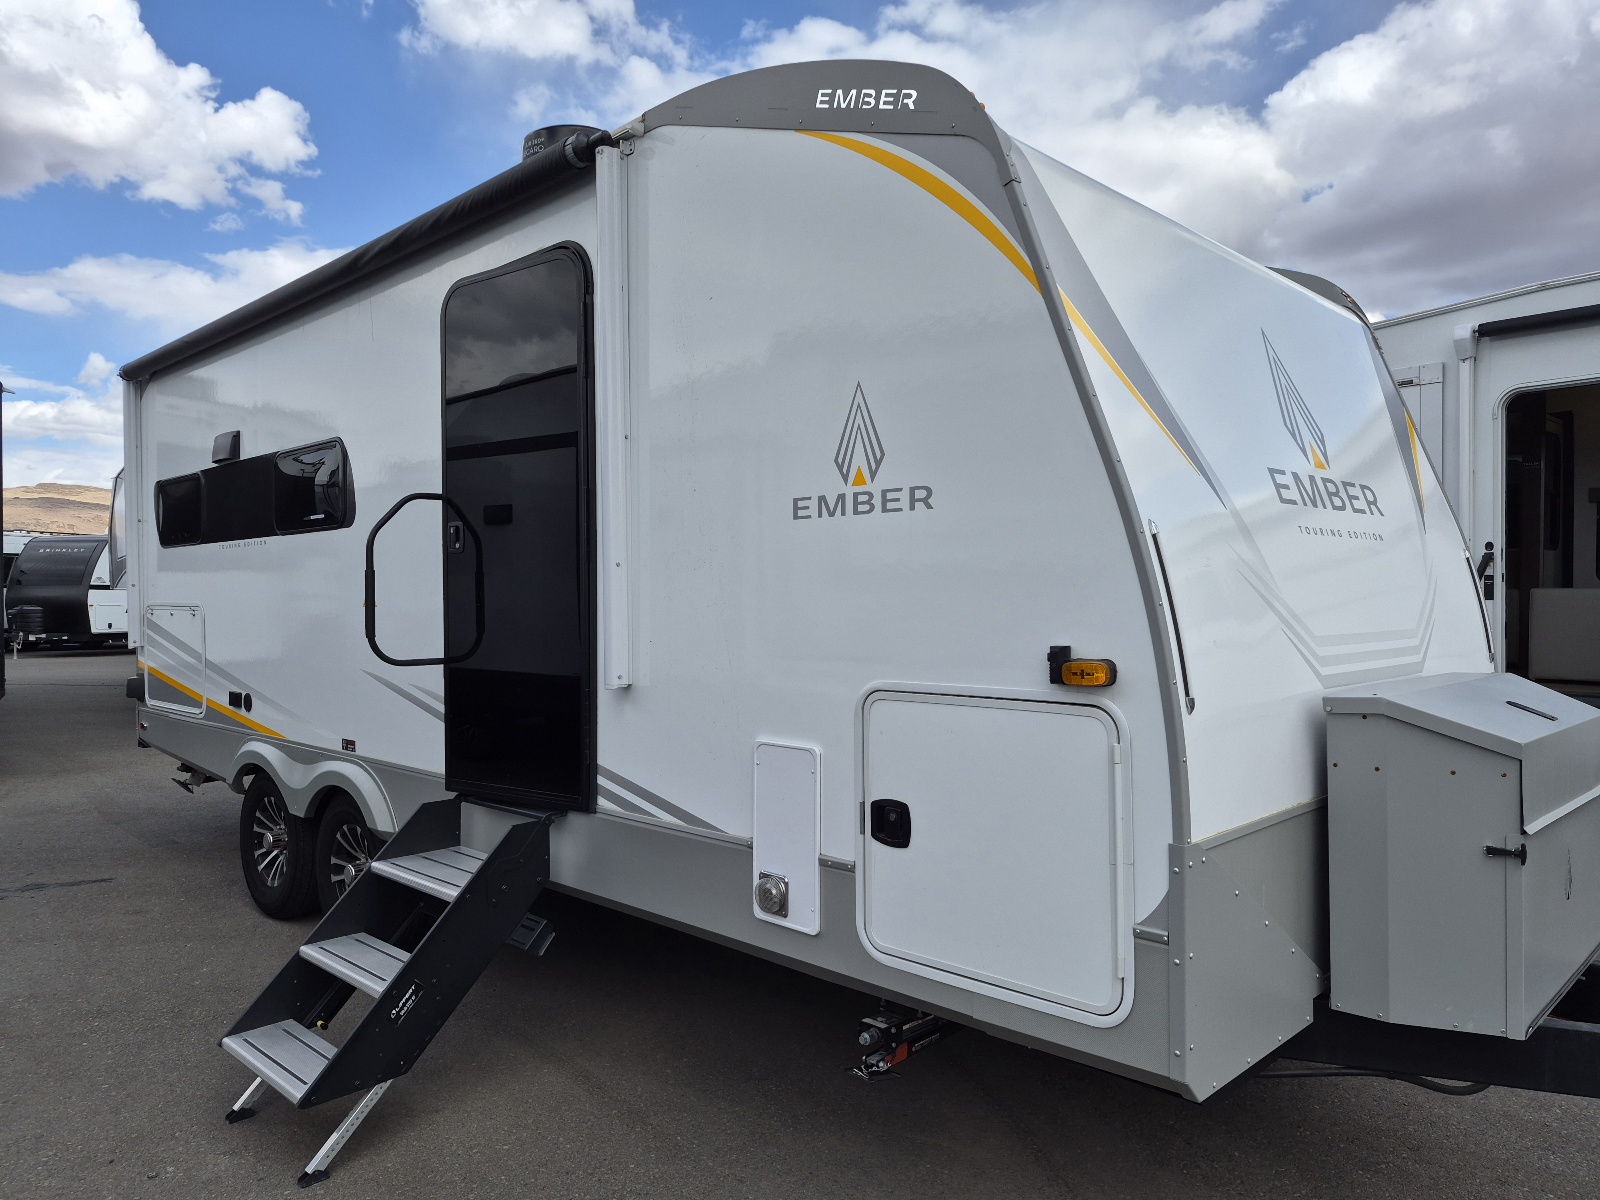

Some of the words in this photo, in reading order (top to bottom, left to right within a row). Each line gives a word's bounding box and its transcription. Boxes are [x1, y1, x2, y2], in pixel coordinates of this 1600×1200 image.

[815, 89, 918, 110] EMBER
[792, 485, 935, 521] EMBER
[1266, 467, 1385, 517] EMBER
[218, 542, 241, 550] TOURING
[243, 540, 267, 548] EDITION
[1297, 525, 1343, 538] TOURING
[1347, 530, 1384, 542] EDITION
[395, 983, 416, 1012] LIPPERT
